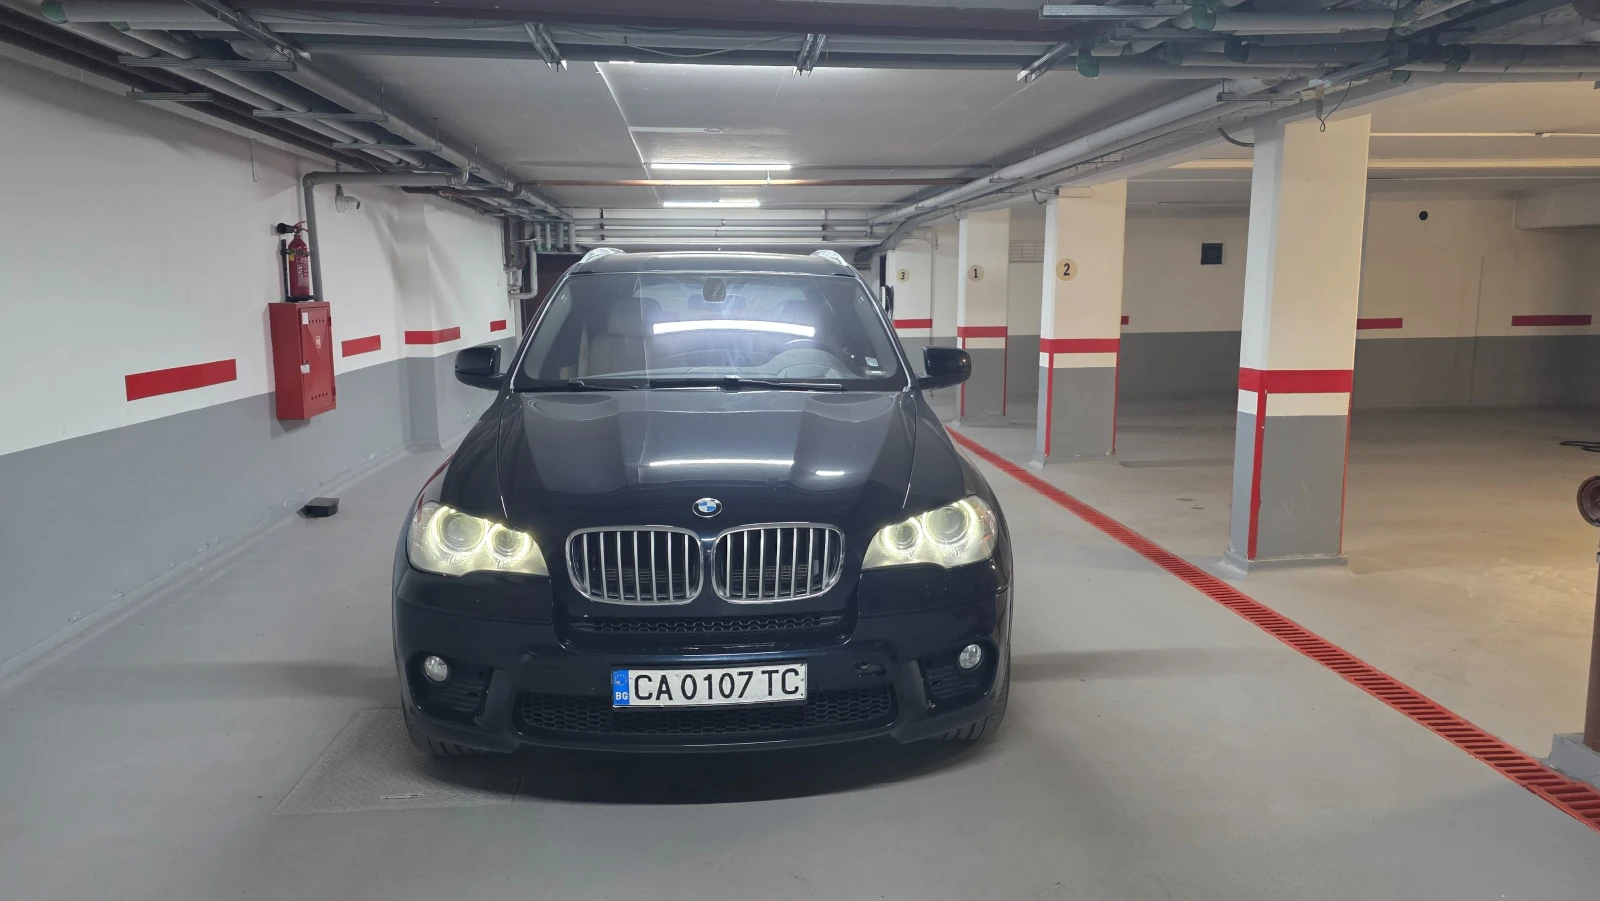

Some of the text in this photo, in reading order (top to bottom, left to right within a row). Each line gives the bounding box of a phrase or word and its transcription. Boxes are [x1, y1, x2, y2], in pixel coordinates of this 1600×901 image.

[973, 268, 978, 279] 1
[1063, 263, 1071, 277] 2
[900, 271, 906, 281] 3
[634, 668, 800, 701] CA 0107 TC
[615, 692, 629, 700] BG
